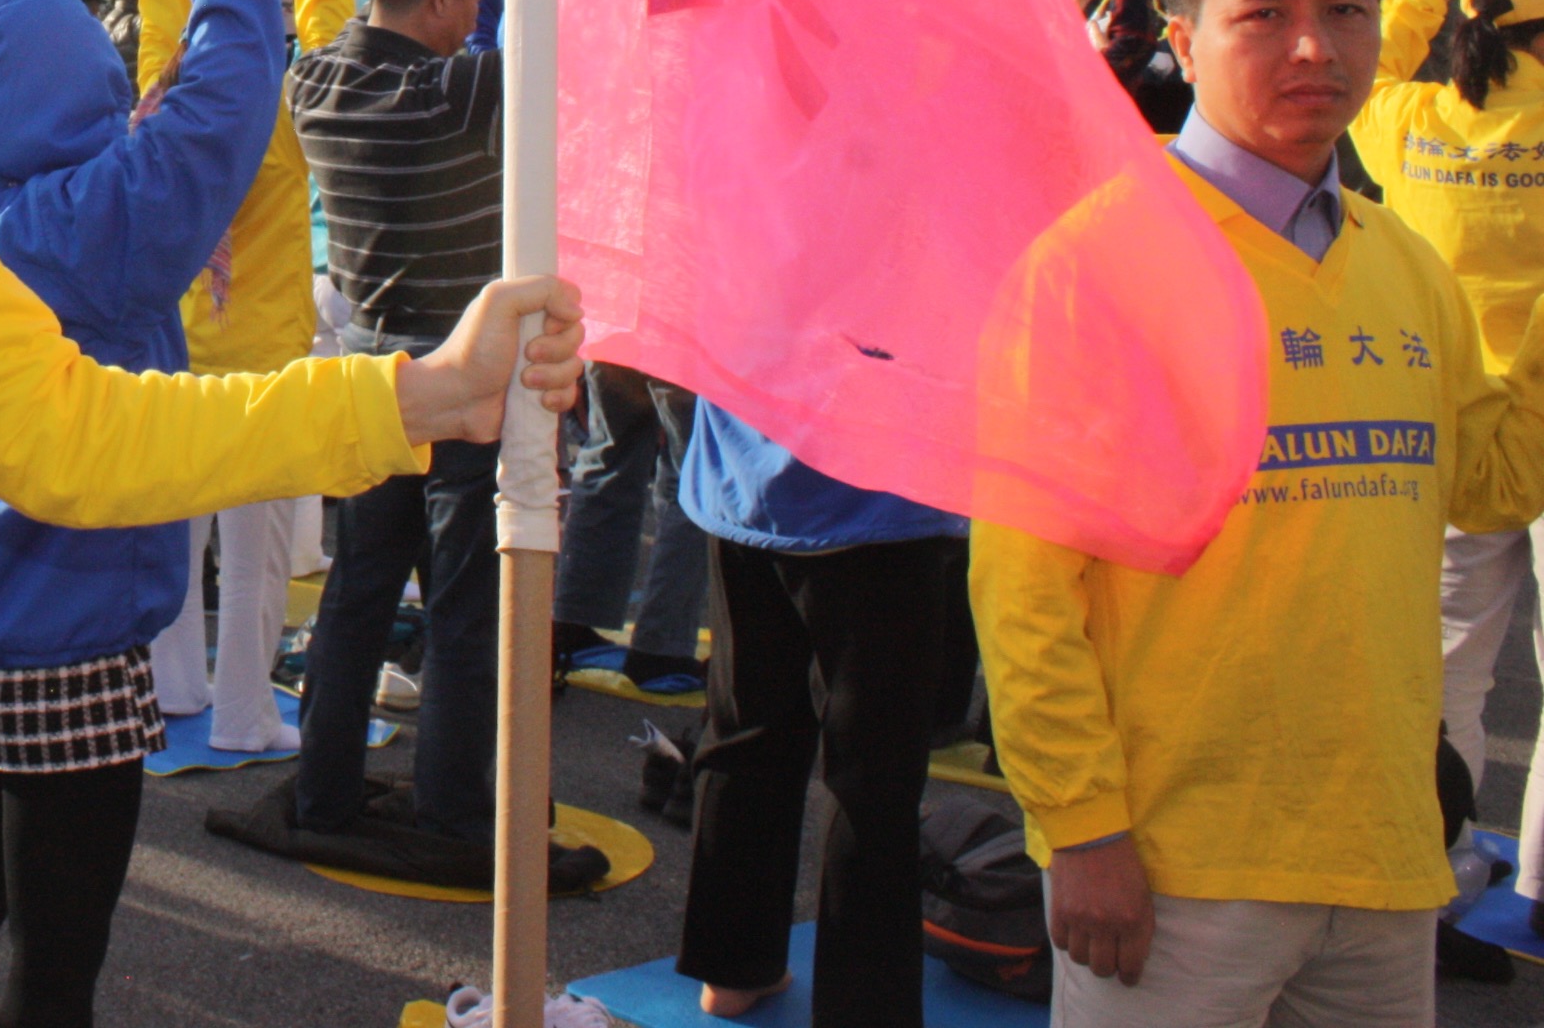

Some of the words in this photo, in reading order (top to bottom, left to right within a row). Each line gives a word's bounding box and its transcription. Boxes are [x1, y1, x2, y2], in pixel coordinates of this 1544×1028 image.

[1435, 169, 1475, 185] DAFA
[1481, 172, 1499, 187] IS
[1259, 429, 1357, 464] ALUN
[1368, 428, 1431, 458] DAFA
